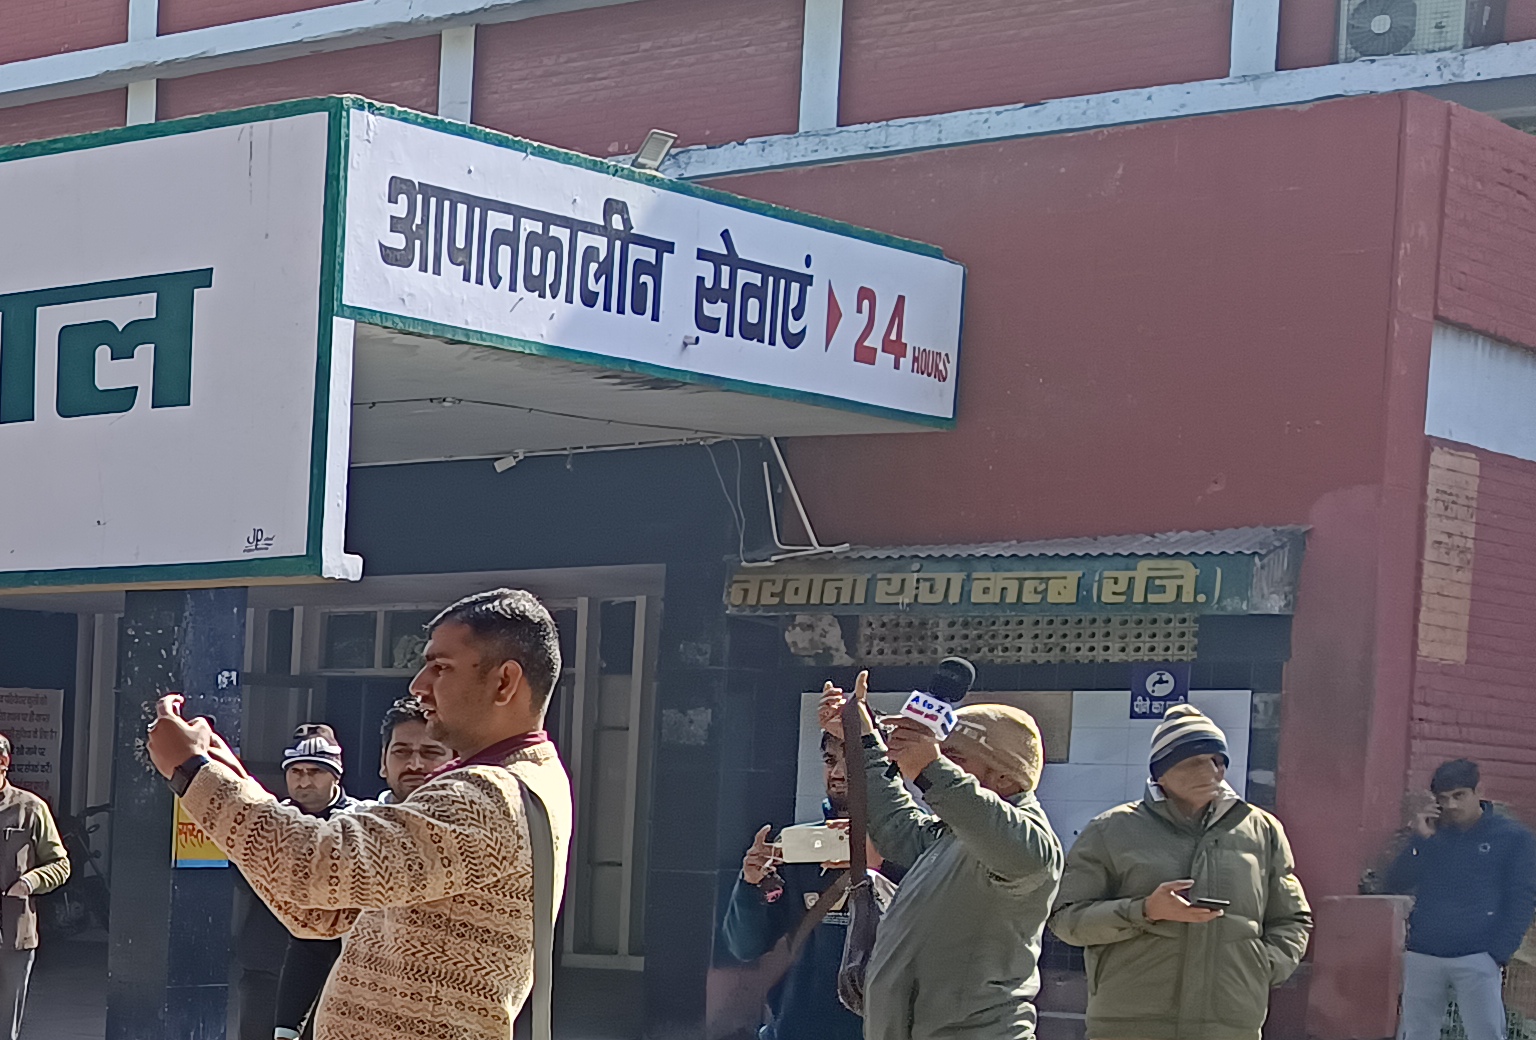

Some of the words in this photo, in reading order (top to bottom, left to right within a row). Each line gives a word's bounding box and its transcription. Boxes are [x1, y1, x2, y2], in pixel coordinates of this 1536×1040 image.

[379, 175, 675, 323] आपातकालीन
[694, 228, 814, 350] सेवाएं
[853, 286, 908, 371] 24
[910, 345, 949, 383] HOURS
[730, 573, 871, 605] नरवाना
[911, 695, 919, 705] A
